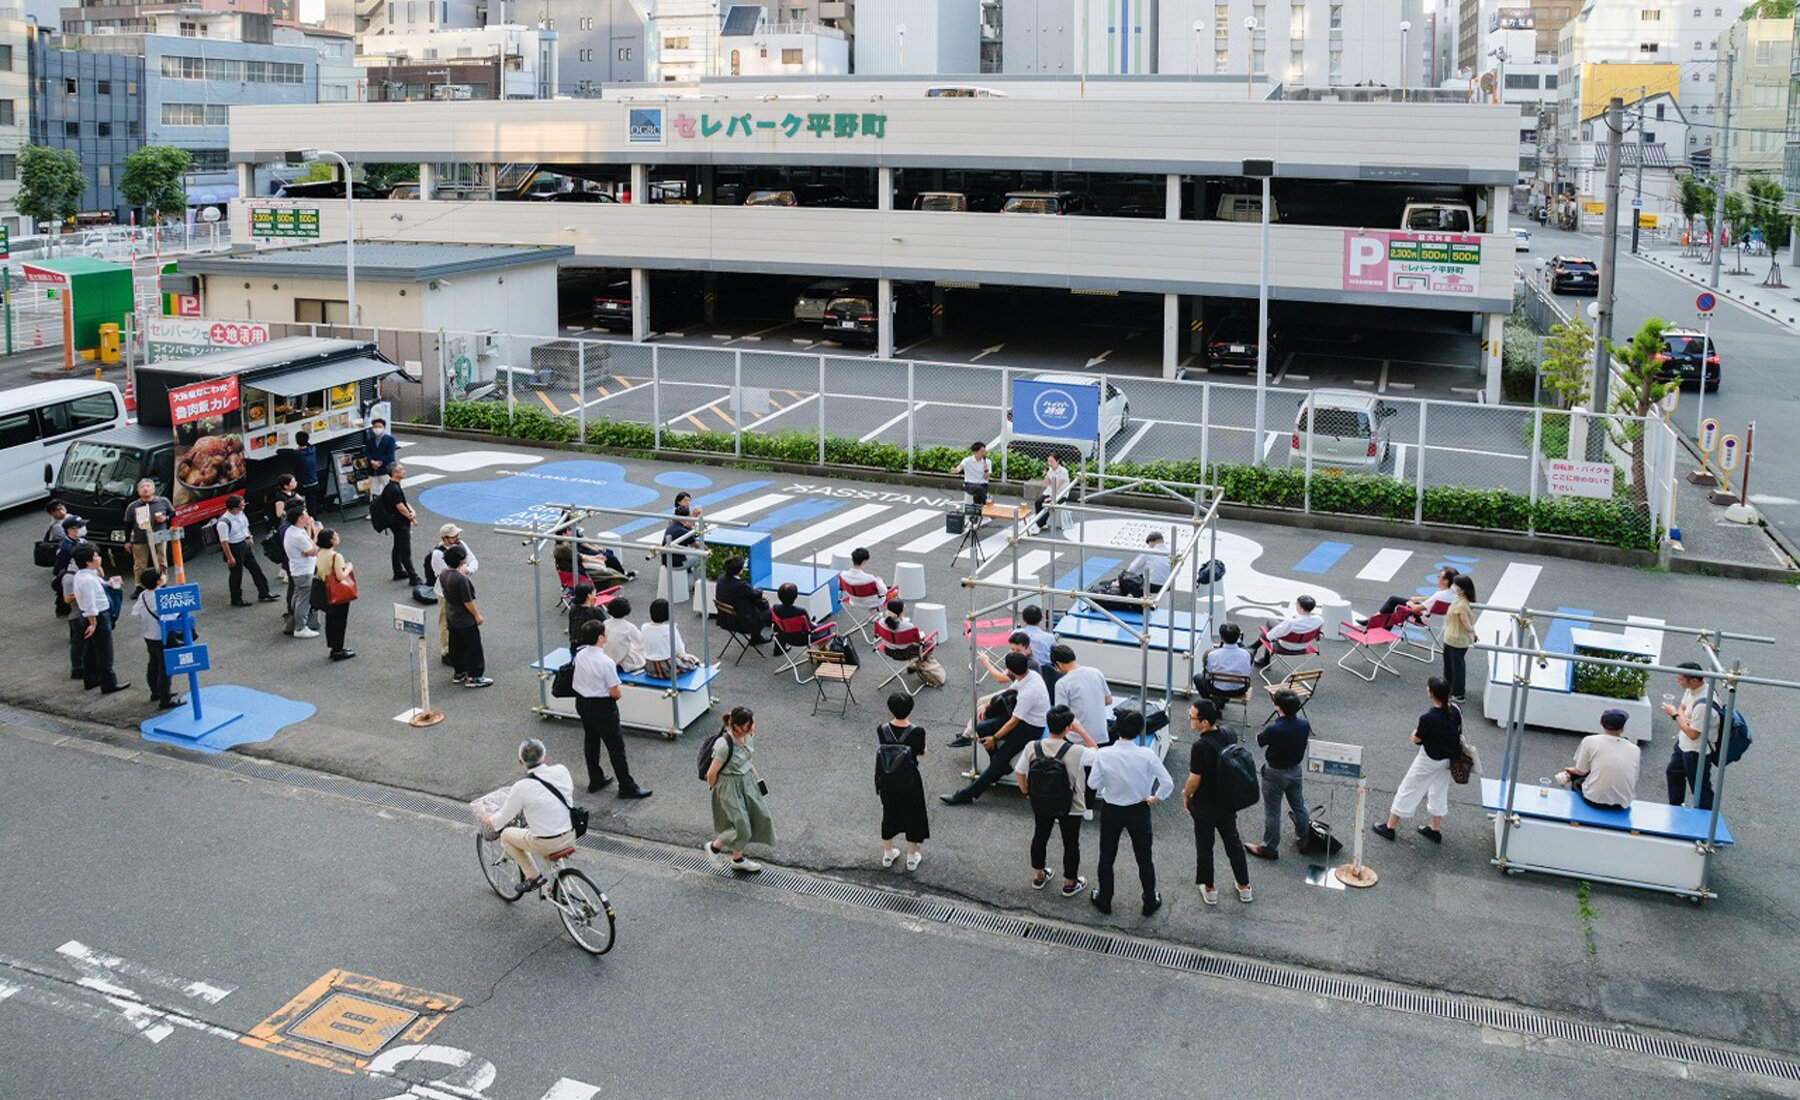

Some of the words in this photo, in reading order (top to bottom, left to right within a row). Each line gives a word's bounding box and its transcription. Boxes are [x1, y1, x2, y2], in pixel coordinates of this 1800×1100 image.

[673, 113, 887, 138] セレパーク平野町
[1349, 236, 1385, 276] P
[1421, 250, 1448, 260] 500円
[1452, 252, 1479, 262] 500円
[1401, 263, 1465, 275] セレパーク平野町
[182, 296, 198, 314] P
